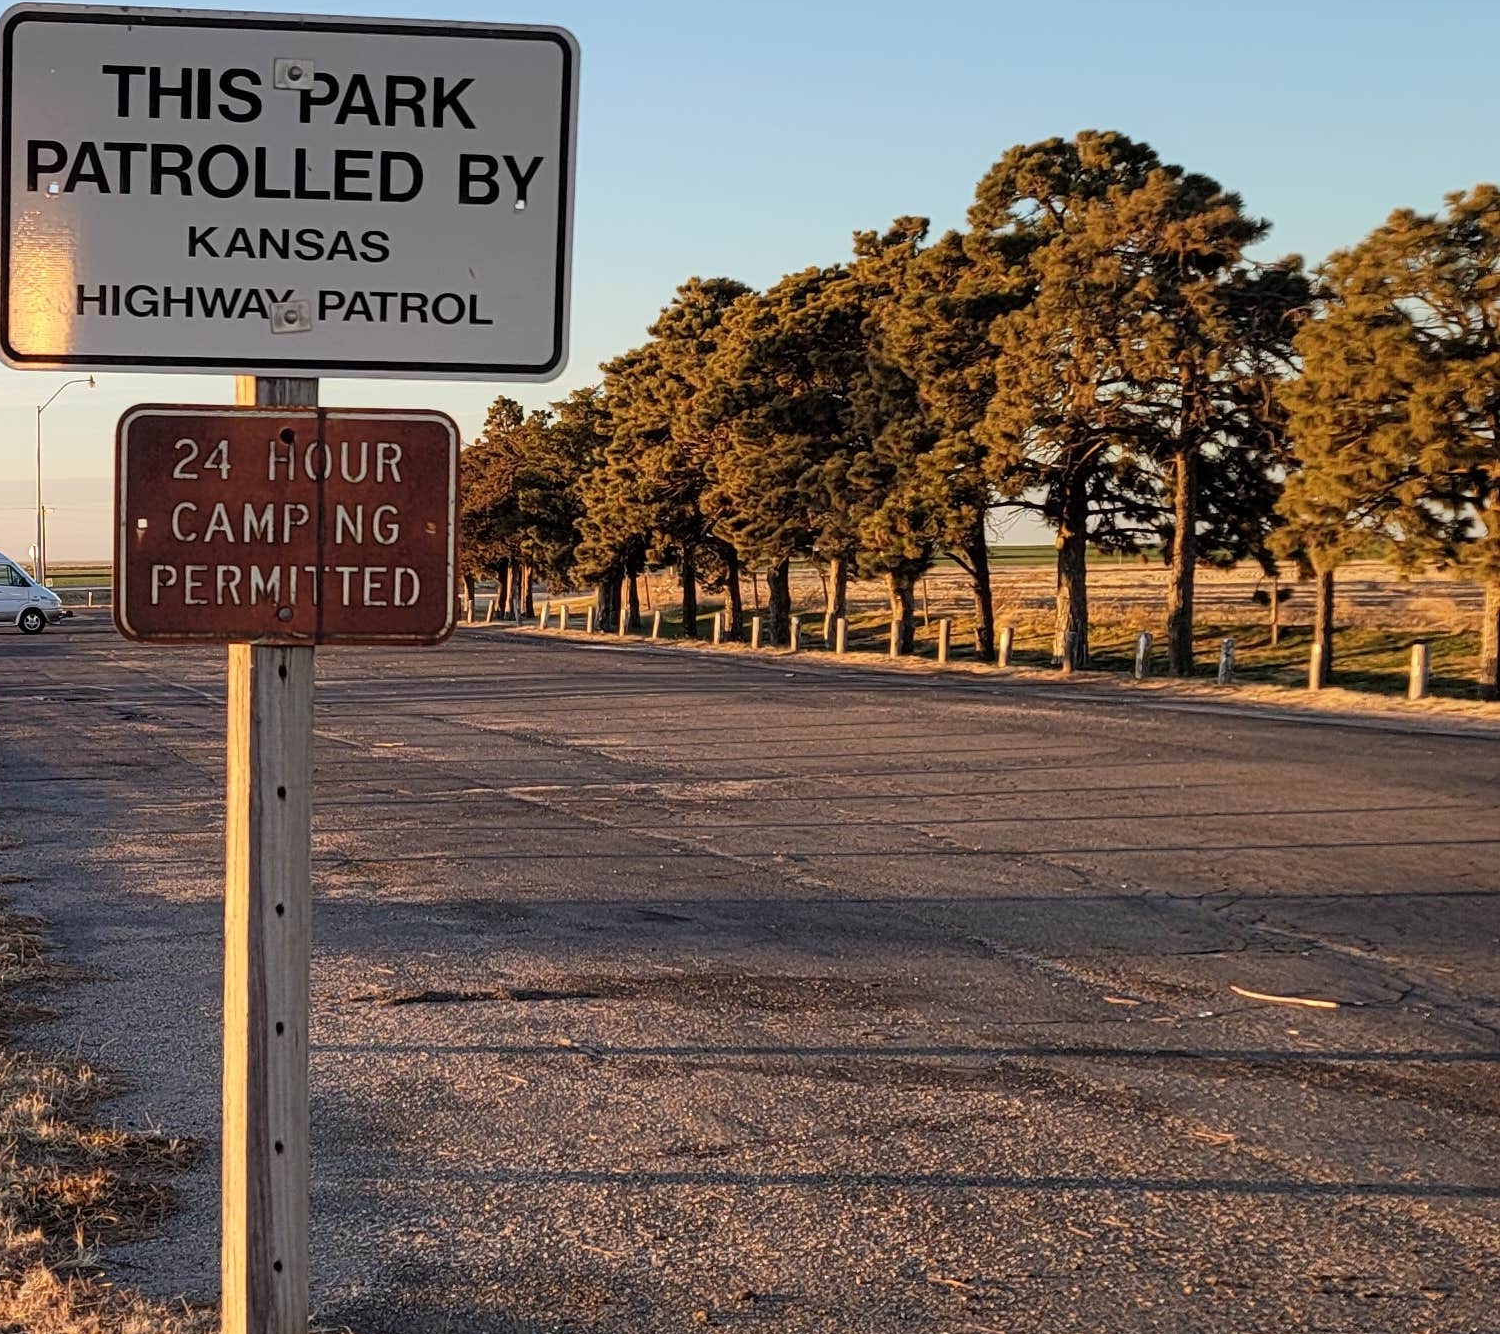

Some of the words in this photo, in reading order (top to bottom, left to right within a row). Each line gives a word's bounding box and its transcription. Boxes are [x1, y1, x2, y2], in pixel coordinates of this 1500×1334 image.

[102, 64, 263, 123] THIS
[299, 71, 477, 130] PARK
[26, 139, 424, 203] PATROLLED
[457, 153, 544, 206] BY
[187, 226, 391, 263] KANSAS
[318, 290, 494, 325] PATROL
[172, 438, 232, 481] 24
[267, 440, 403, 484] HOUR
[171, 501, 400, 545] CAMPNG
[150, 564, 421, 607] PERMITTED
